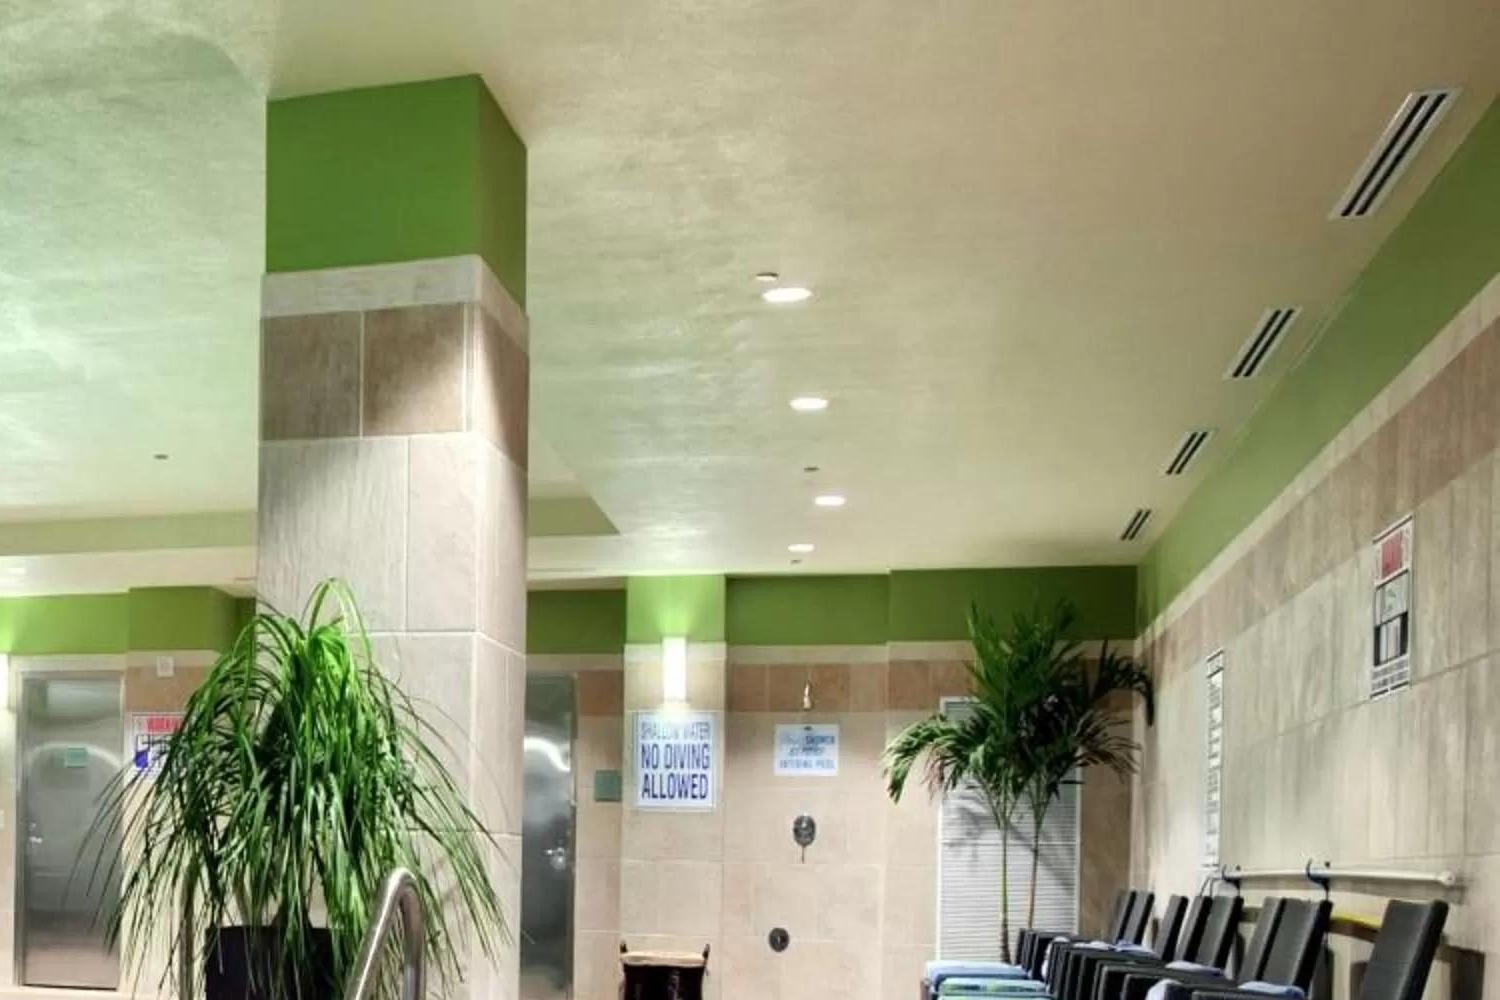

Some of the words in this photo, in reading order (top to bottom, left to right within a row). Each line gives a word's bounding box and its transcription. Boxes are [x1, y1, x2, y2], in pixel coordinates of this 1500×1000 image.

[641, 743, 659, 770] NO
[664, 743, 710, 770] DIVING
[641, 773, 709, 799] ALLOWED
